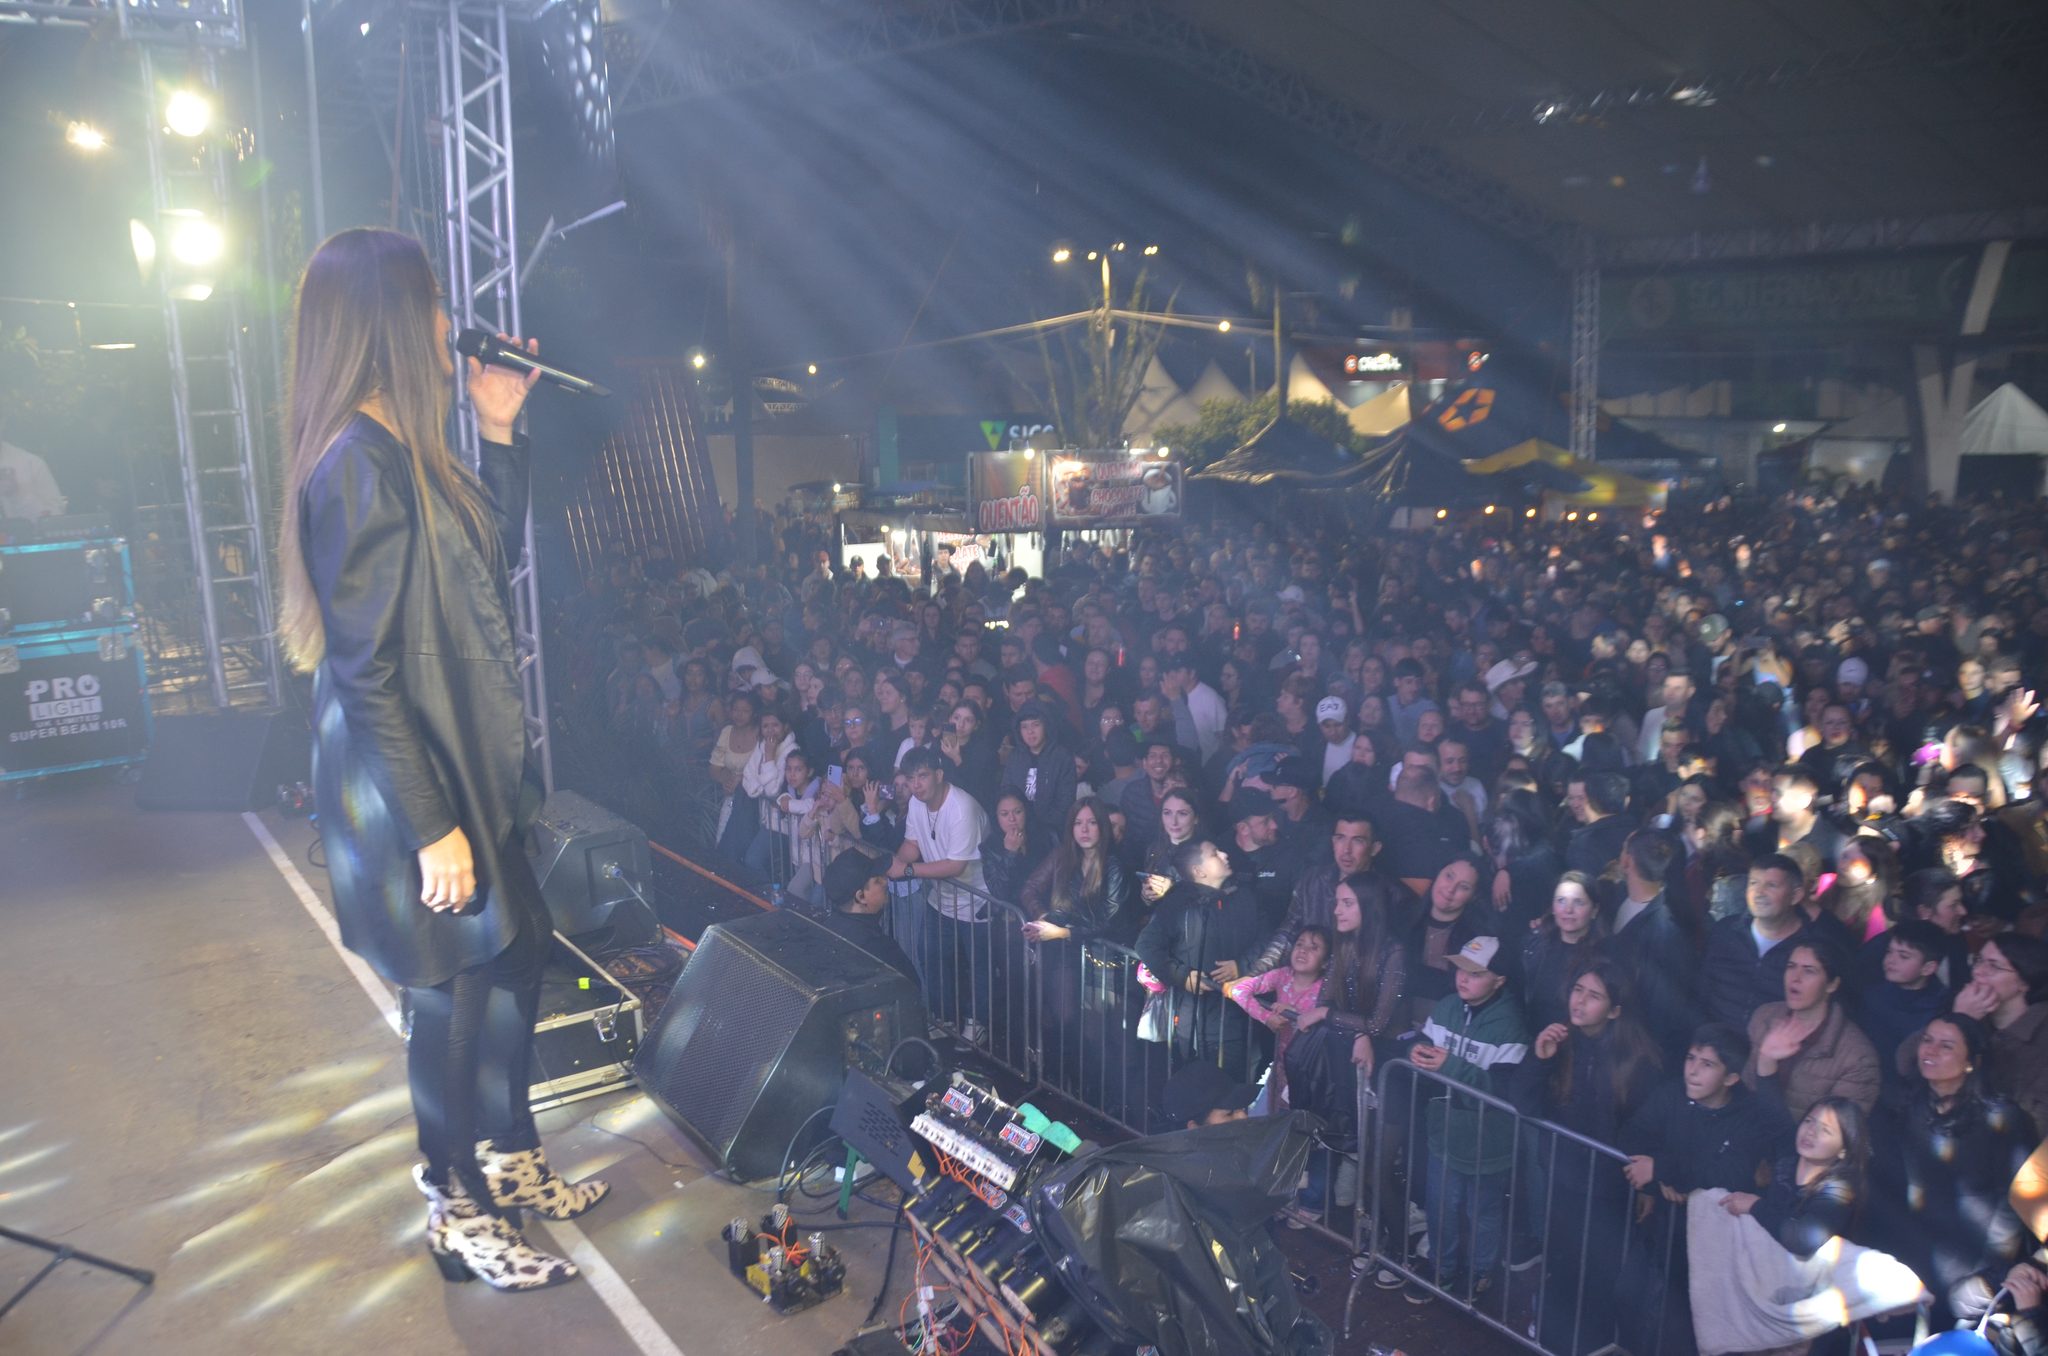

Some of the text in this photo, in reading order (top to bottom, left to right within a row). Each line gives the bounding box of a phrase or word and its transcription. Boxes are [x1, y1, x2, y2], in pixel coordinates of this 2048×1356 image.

[1091, 485, 1145, 505] CHOCOLATE
[979, 485, 1039, 532] QUENTÃO
[24, 674, 100, 702] PRO
[34, 698, 98, 719] LIGHT
[56, 714, 100, 726] LIMITED
[9, 727, 58, 743] SUPER
[60, 721, 100, 736] BEAM
